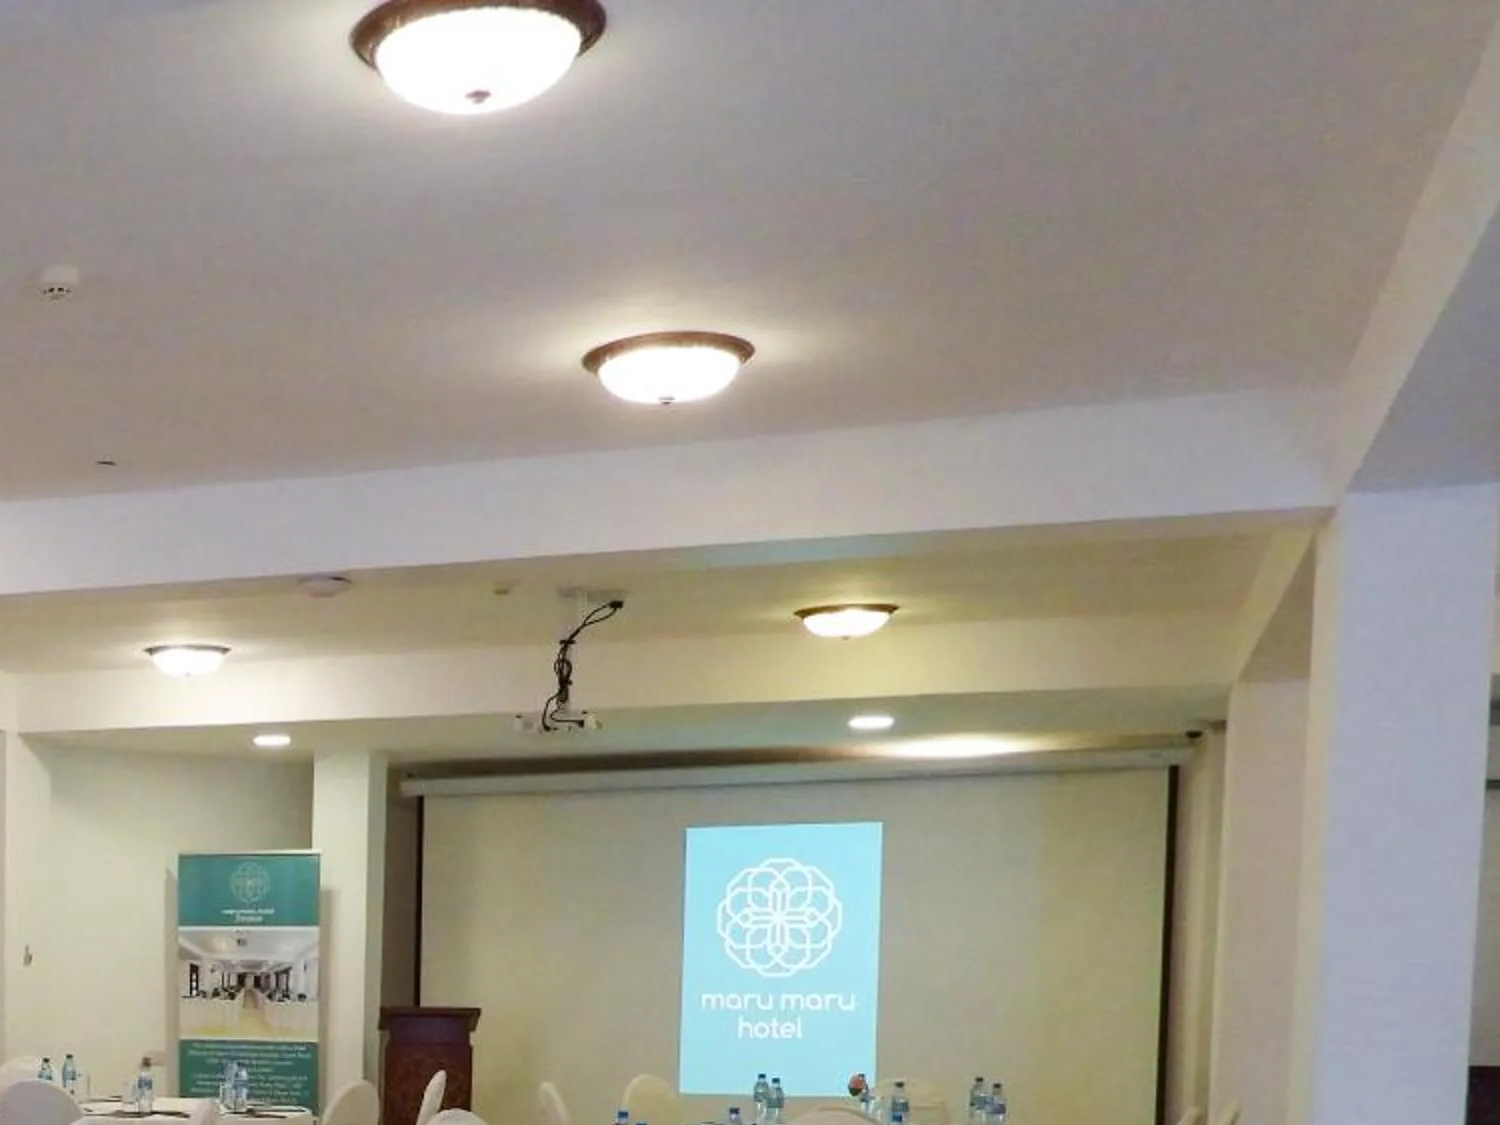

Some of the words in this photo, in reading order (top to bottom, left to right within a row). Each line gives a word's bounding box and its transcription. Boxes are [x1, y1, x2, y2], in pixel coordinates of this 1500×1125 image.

[701, 992, 773, 1010] maru
[780, 992, 856, 1011] maru
[737, 1015, 803, 1039] hotel
